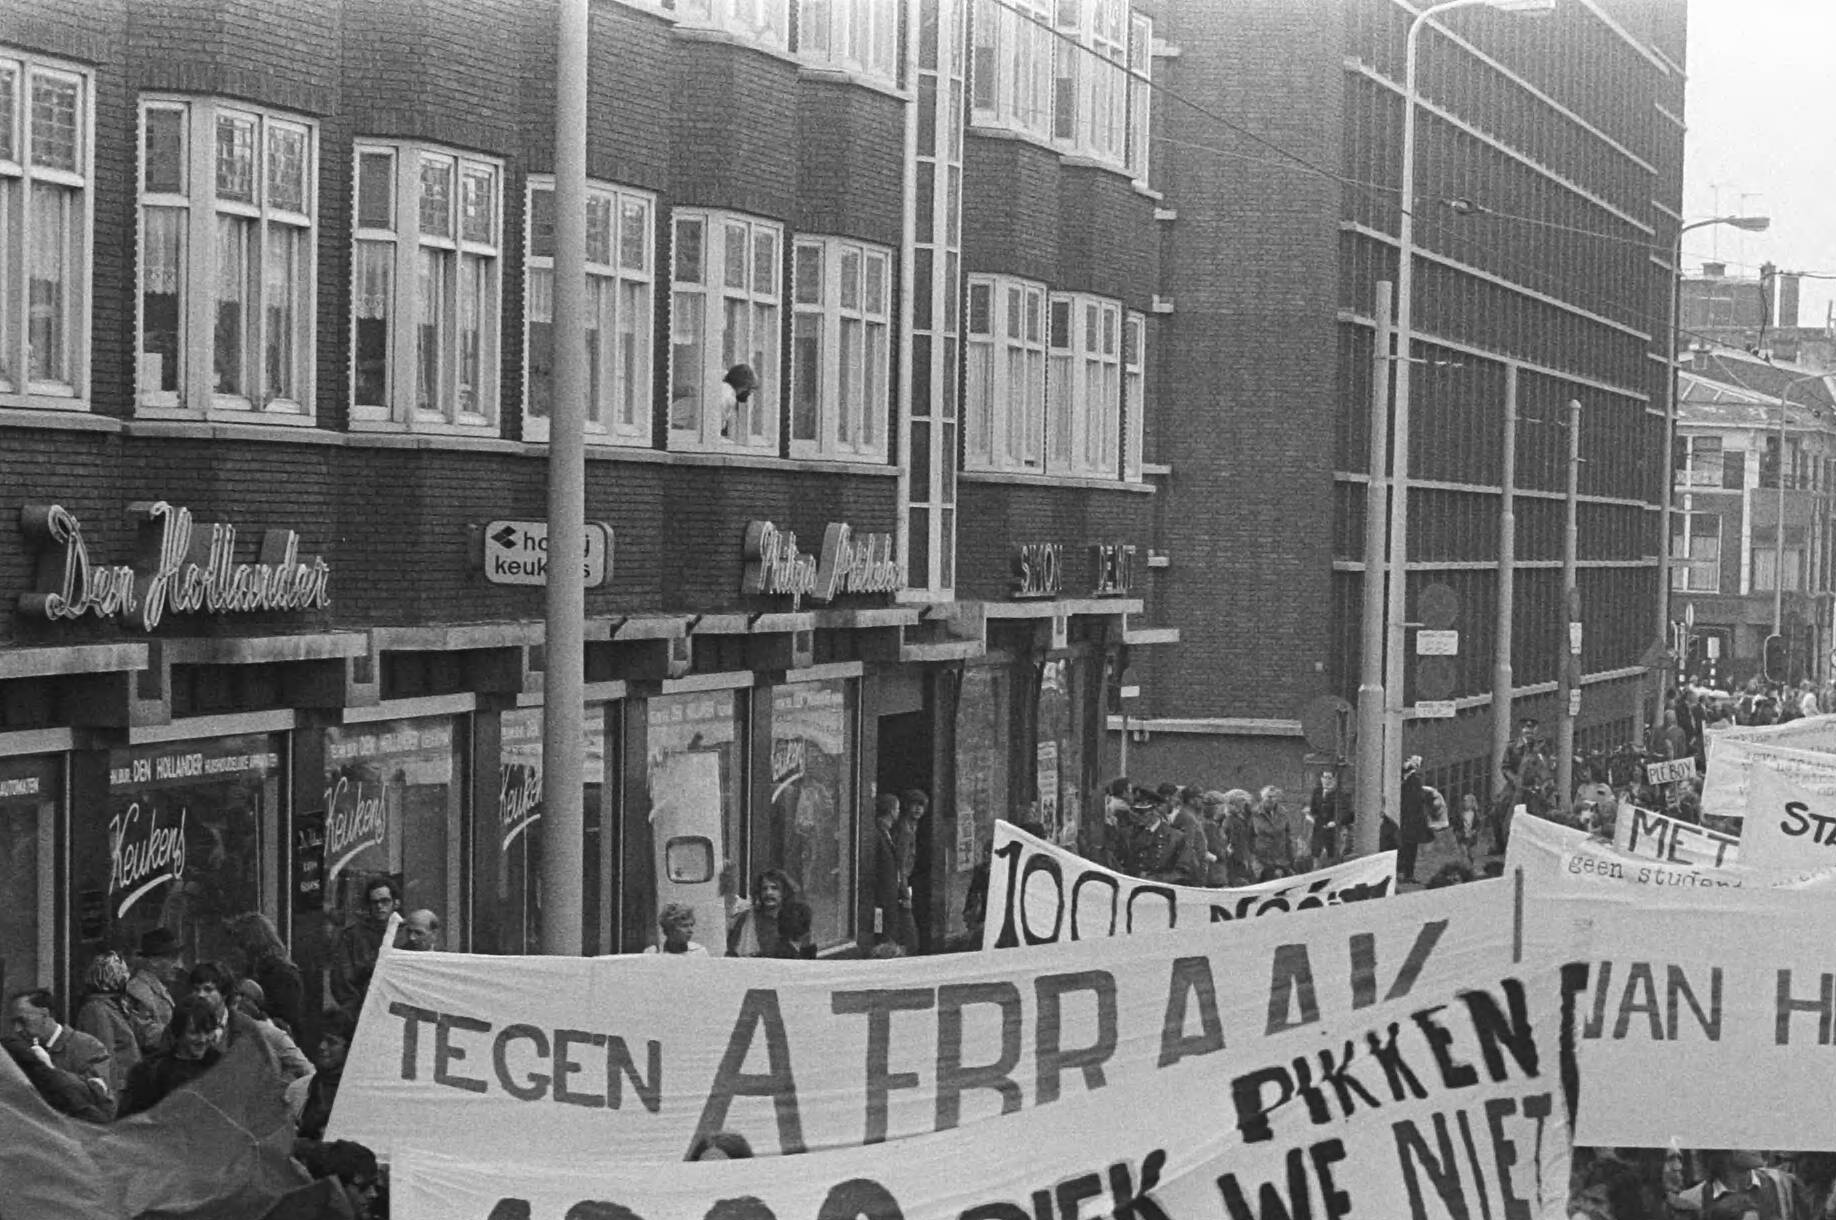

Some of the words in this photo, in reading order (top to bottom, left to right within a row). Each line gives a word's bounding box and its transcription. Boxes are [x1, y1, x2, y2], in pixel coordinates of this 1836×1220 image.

[46, 504, 136, 620] Den
[144, 500, 330, 632] Hollander
[495, 555, 590, 578] keuks
[109, 802, 186, 897] Keukens
[324, 776, 388, 857] Keukens
[1628, 808, 1741, 867] MET
[1567, 853, 1624, 881] geen
[388, 1002, 663, 1114] TEGEN
[1230, 977, 1542, 1145] PIKKEN
